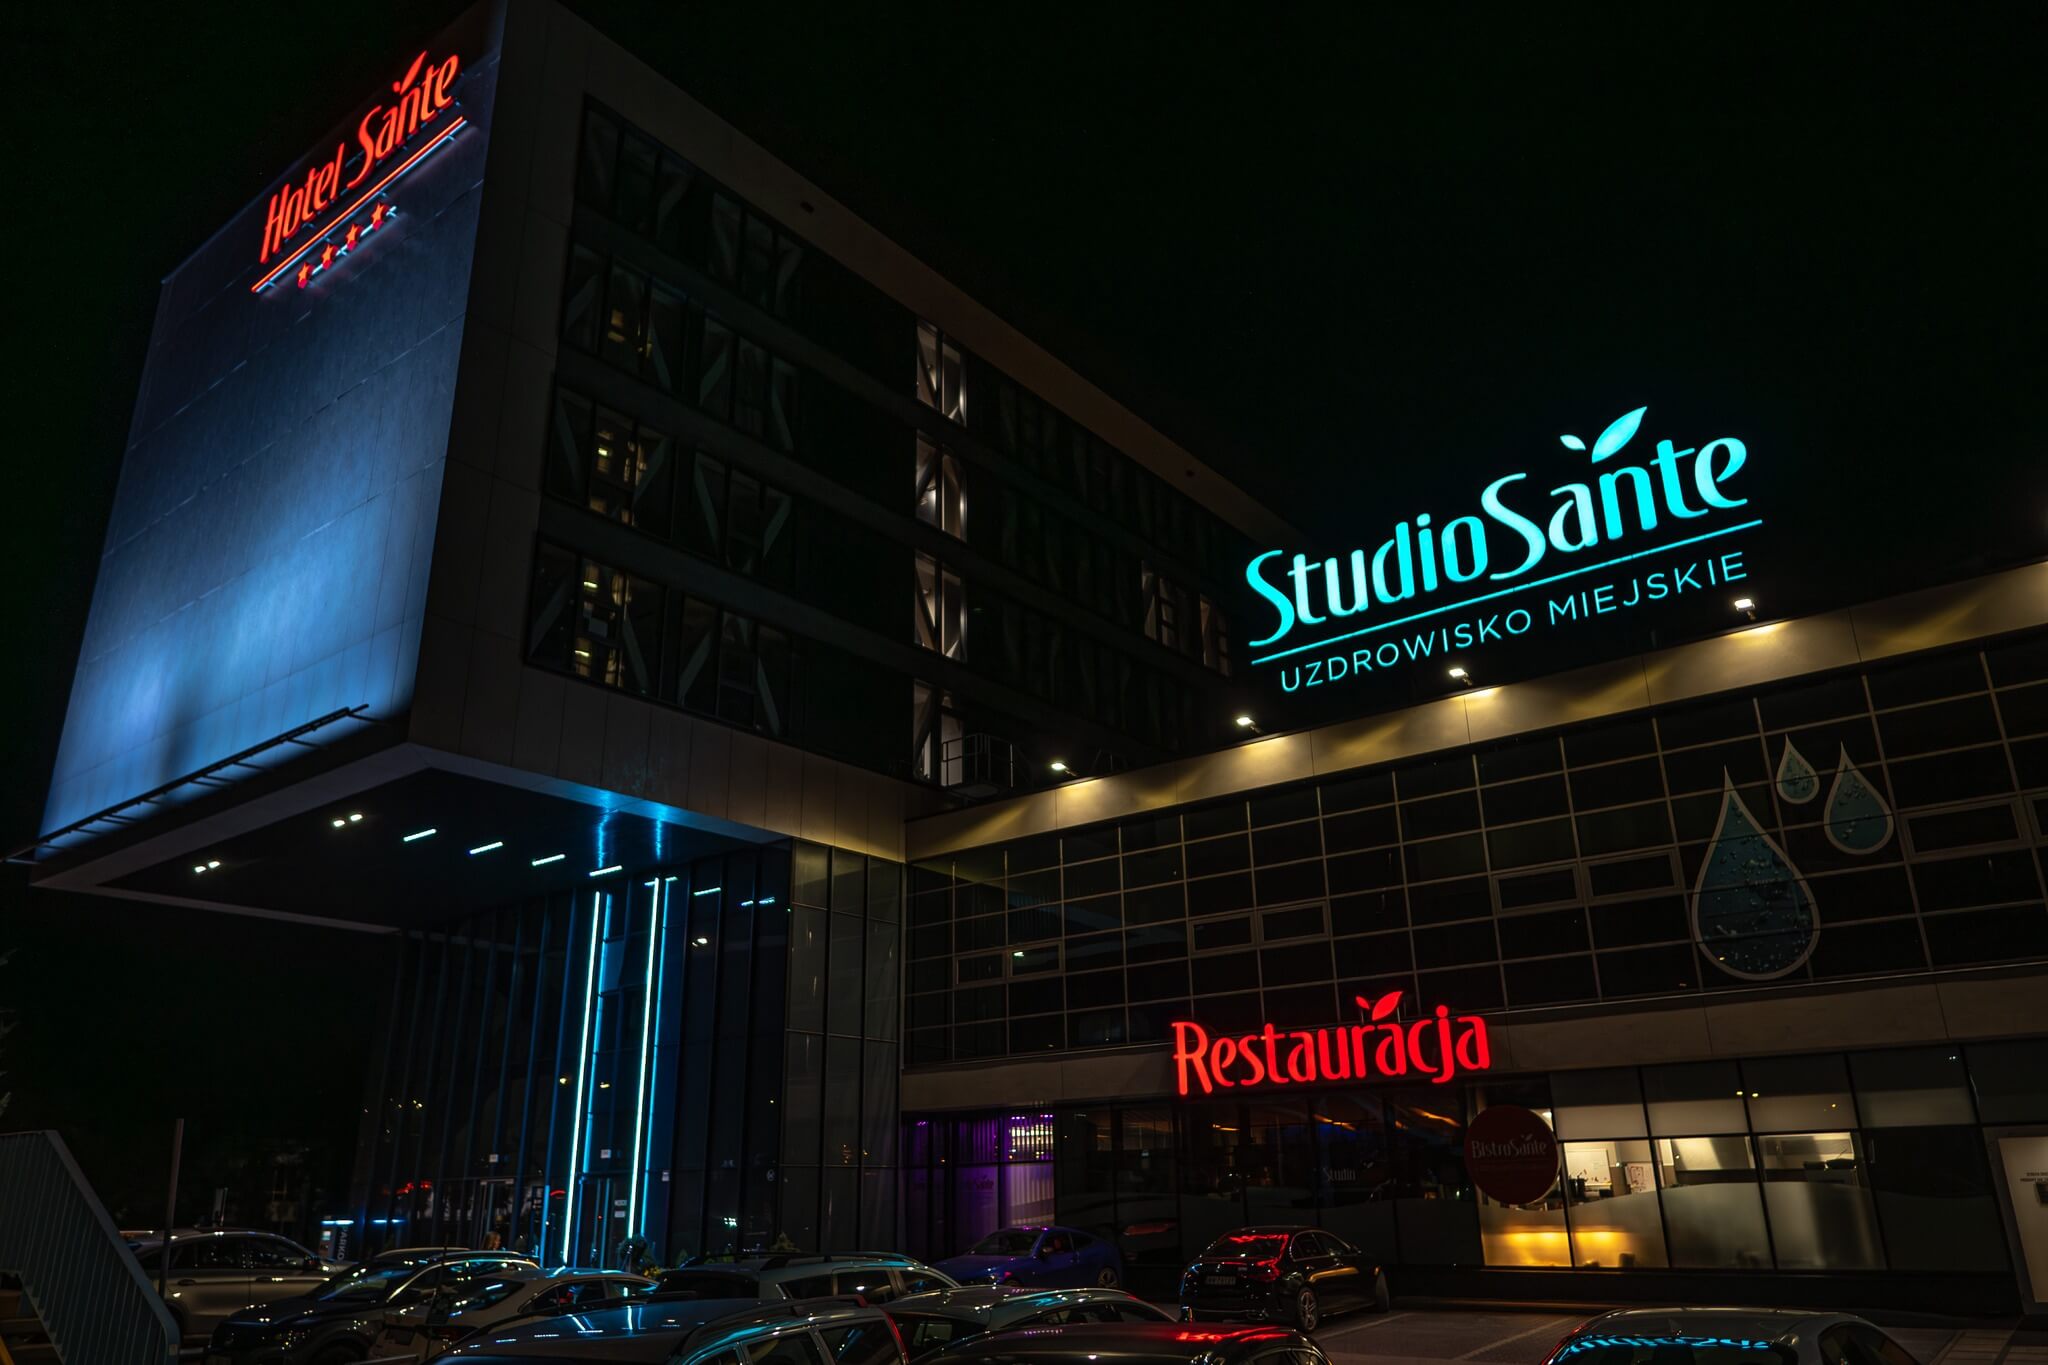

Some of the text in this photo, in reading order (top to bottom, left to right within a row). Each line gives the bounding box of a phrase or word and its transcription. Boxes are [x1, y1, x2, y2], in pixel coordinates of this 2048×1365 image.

[259, 52, 461, 264] Hotel Sante
[1245, 435, 1748, 647] StudioSante
[1280, 551, 1748, 694] UZDROWISKO MIEJSKIE
[1171, 1003, 1491, 1097] Restauracja
